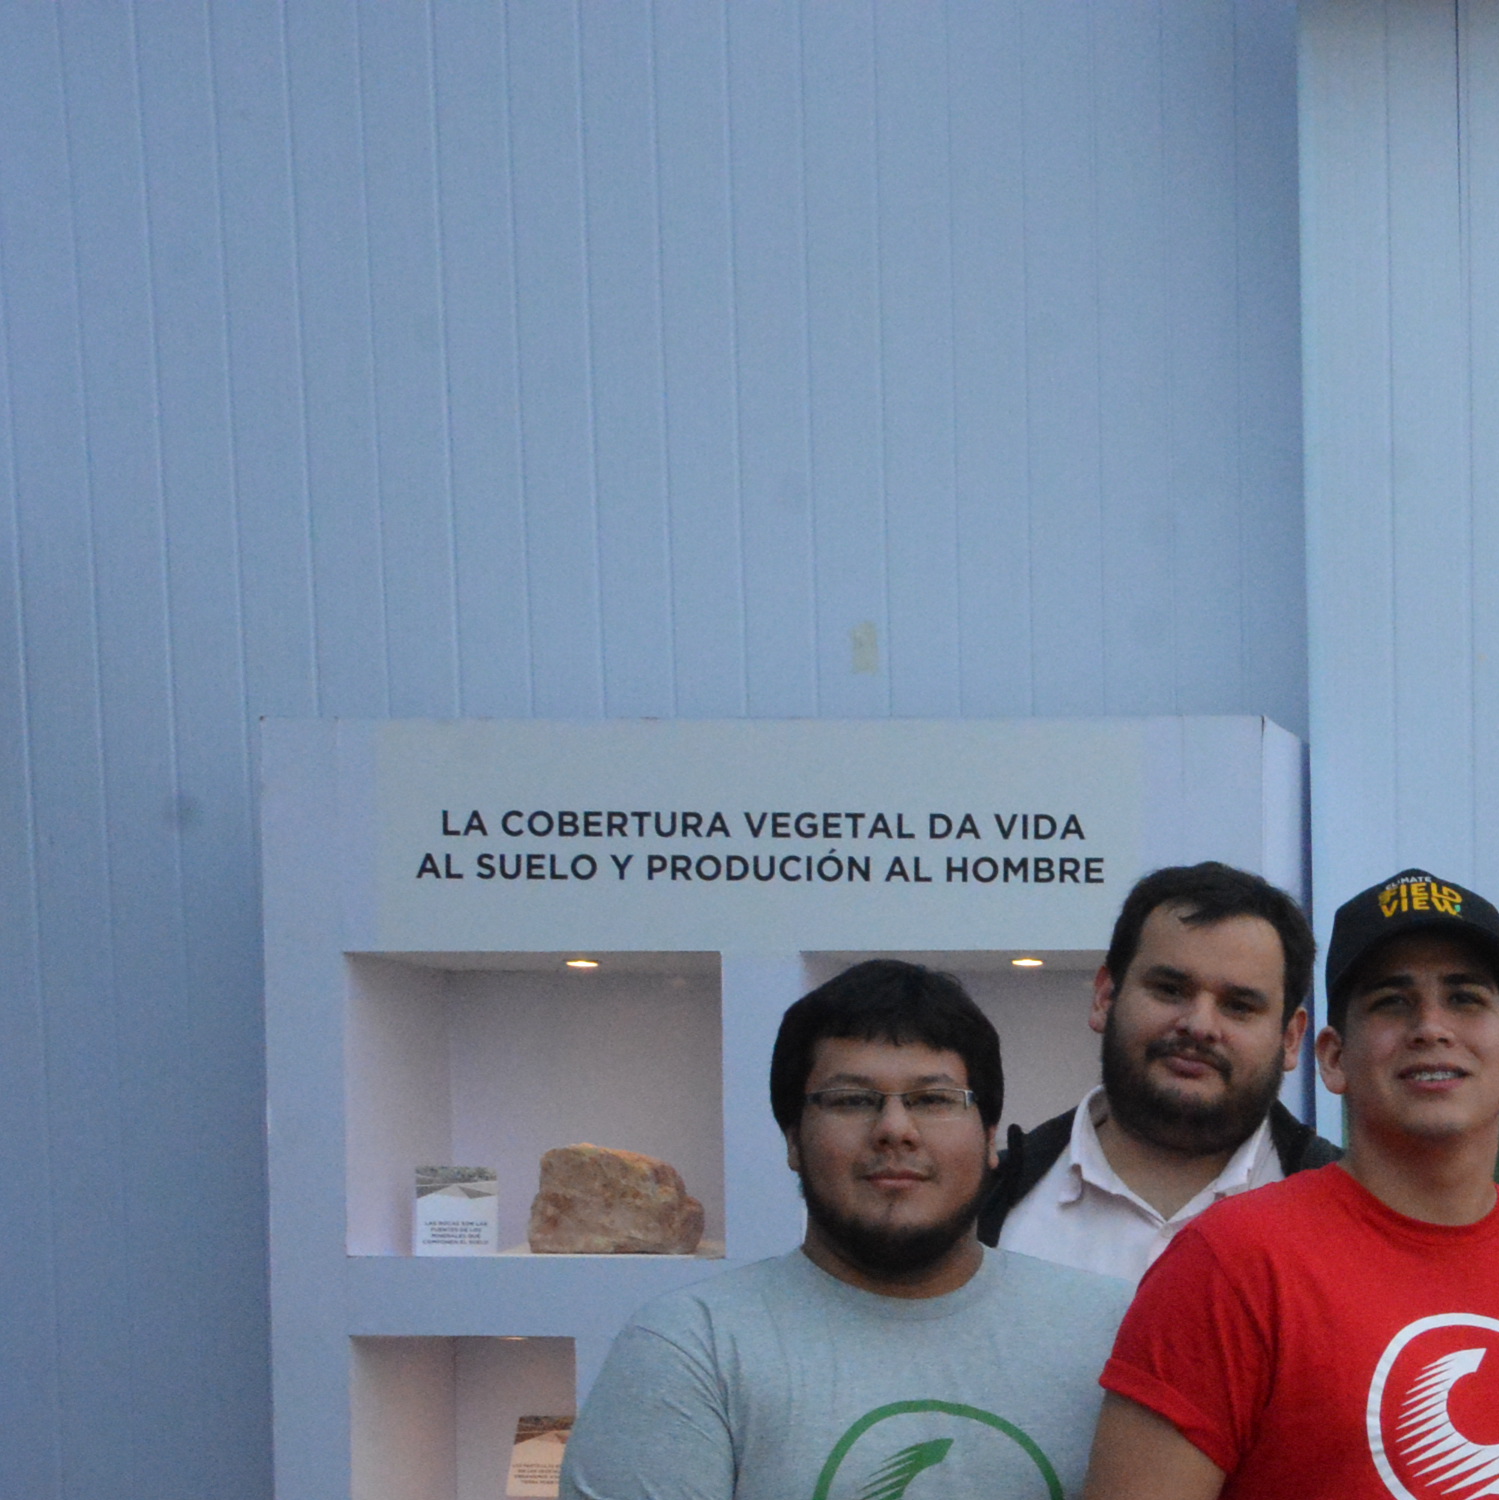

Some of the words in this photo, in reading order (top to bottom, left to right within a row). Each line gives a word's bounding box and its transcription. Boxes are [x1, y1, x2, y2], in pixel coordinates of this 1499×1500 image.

[441, 809, 489, 837] LA
[501, 809, 732, 838] COBERTURA
[744, 811, 916, 839] VEGETAL
[928, 812, 981, 840] DA
[994, 813, 1086, 841] VIDA
[416, 853, 464, 880] AL
[476, 853, 598, 881] SUELO
[610, 854, 634, 882] Y
[647, 848, 872, 883] PRODUCIÓN
[885, 855, 933, 883] AL
[945, 856, 1105, 885] HOMBRE
[1378, 882, 1463, 906] FIELD
[1385, 875, 1433, 891] CLIMATE
[1380, 896, 1458, 918] VIEW
